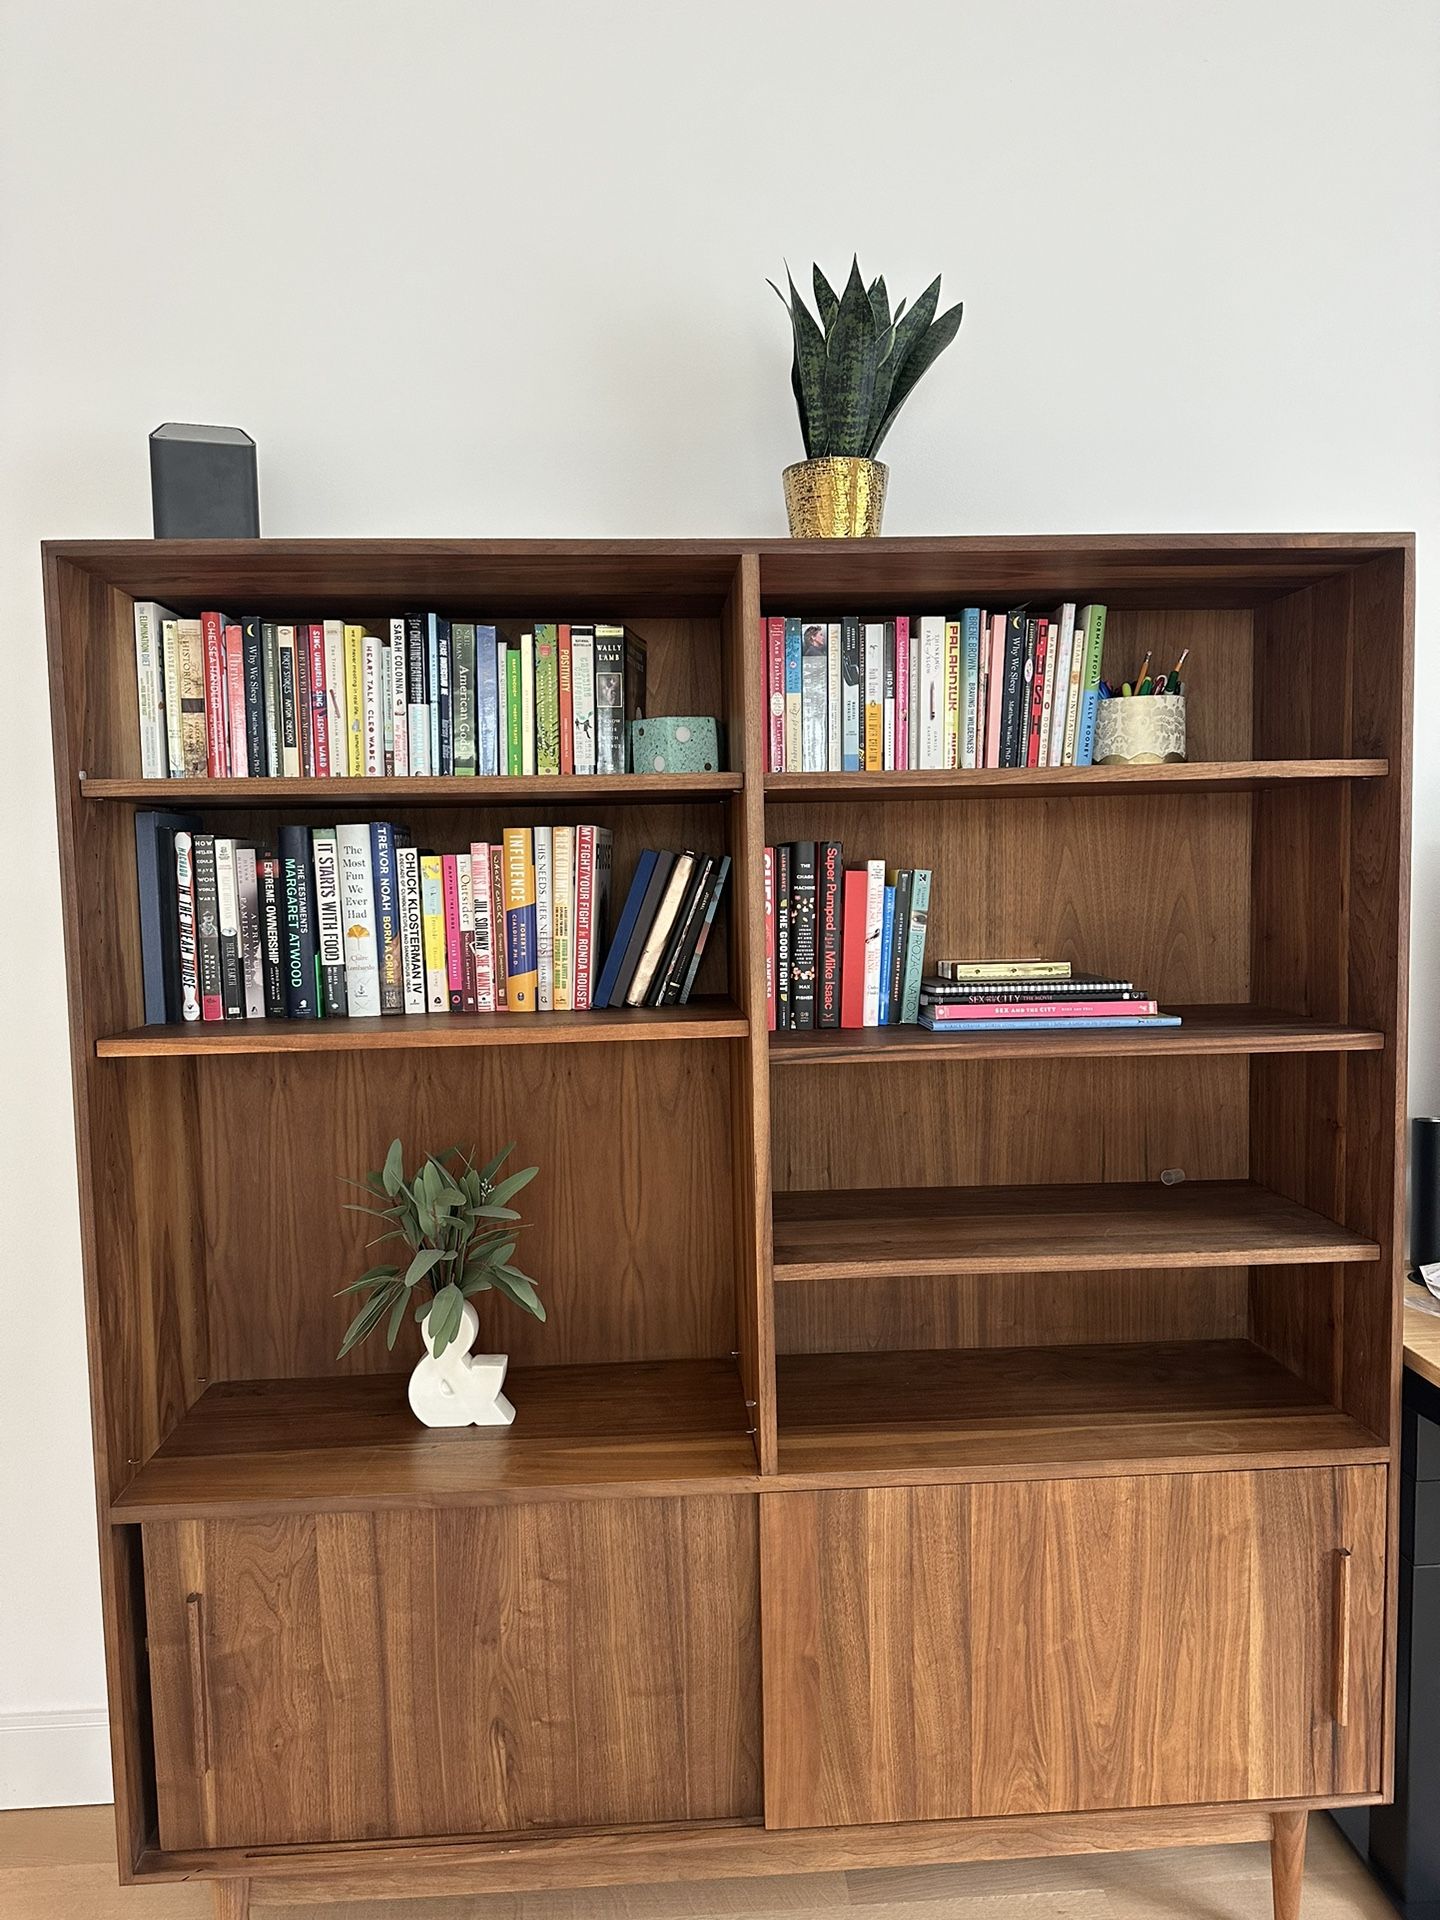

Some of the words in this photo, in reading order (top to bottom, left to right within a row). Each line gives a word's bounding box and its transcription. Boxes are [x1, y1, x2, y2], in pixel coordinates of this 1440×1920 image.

[140, 615, 149, 653] ELIMINATION
[207, 621, 215, 664] CHELSEA
[312, 630, 320, 649] SING,
[394, 624, 402, 652] SARAH
[410, 630, 422, 660] CHEATING
[439, 640, 447, 656] PLEASE
[1011, 637, 1020, 656] Why
[1094, 616, 1102, 651] NORMAL
[142, 654, 150, 666] DIET
[247, 645, 257, 665] Why
[282, 651, 291, 669] FORTY
[830, 629, 838, 670] Modern
[968, 643, 977, 670] BROWN
[1011, 657, 1019, 670] We
[182, 640, 192, 694] HISTORIAN
[228, 652, 241, 689] Thrive
[249, 666, 258, 680] We
[298, 650, 307, 694] BELOVED
[314, 652, 322, 690] UNBURIED,
[395, 655, 403, 695] COLONNA
[411, 661, 423, 682] DEATH
[440, 657, 448, 686] UNDERSTAND
[561, 649, 570, 692] POSITIVITY
[949, 625, 958, 711] PALAHNIUK
[1046, 663, 1054, 695] OLIVER
[210, 666, 219, 709] HANDLER
[249, 681, 258, 704] Sleep
[283, 671, 291, 694] STORIES
[459, 665, 469, 720] American
[831, 672, 839, 698] Love
[968, 683, 976, 708] BRAVING
[1008, 672, 1018, 694] Sleep
[284, 699, 292, 718] ANTON
[315, 690, 324, 707] SING
[285, 720, 294, 745] CHEKHOV
[317, 714, 326, 743] JESMYN
[460, 723, 470, 750] Gods
[967, 716, 975, 754] WILDERNESS
[1066, 700, 1076, 748] INVITATION
[1084, 725, 1092, 758] ROONEY
[319, 746, 327, 767] WARD
[318, 843, 333, 853] IT
[581, 827, 591, 841] MY
[178, 847, 187, 878] MACHADO
[343, 859, 366, 867] Most
[344, 846, 362, 855] The
[378, 827, 388, 874] TREVOR
[538, 844, 546, 862] HIS
[825, 847, 837, 881] Super
[297, 864, 305, 879] THE
[318, 857, 335, 898] STARTS
[346, 871, 364, 880] Fun
[405, 852, 416, 895] CHUCK
[473, 861, 486, 886] WANTS
[510, 834, 524, 901] INFLUENCE
[538, 864, 547, 898] NEEDS,
[555, 829, 569, 904] FREAKONOMICS
[580, 844, 591, 900] FIGHT/YOUR
[179, 885, 191, 895] IN
[264, 862, 274, 903] EXTREME
[285, 858, 299, 929] MARGARET
[348, 885, 364, 894] We
[381, 878, 391, 910] NOAH
[180, 900, 192, 918] THE
[298, 881, 308, 933] TESTAMENTS
[345, 897, 368, 906] Ever
[460, 874, 472, 924] Outsider
[475, 899, 488, 914] JILL
[539, 901, 547, 920] HER
[824, 883, 837, 930] Pumped
[240, 897, 248, 938] FAMILY
[321, 901, 337, 930] WITH
[347, 910, 367, 919] Had
[579, 902, 590, 929] FIGHT
[779, 909, 787, 928] THE
[181, 922, 193, 953] DREAM
[266, 905, 279, 964] OWNERSHIP
[382, 916, 392, 944] BORN
[408, 899, 421, 979] KLOSTERMAN
[474, 917, 489, 951] SOLOWAY
[539, 924, 548, 956] NEEDS
[226, 943, 235, 957] HERE
[323, 934, 339, 961] FOOD
[577, 938, 588, 970] RONDA
[779, 931, 787, 959] GOOD
[910, 934, 922, 976] PROZAC
[182, 958, 195, 988] HOUSE
[289, 933, 302, 988] ATWOOD
[384, 954, 395, 984] CRIME
[477, 955, 489, 967] SHE
[825, 951, 836, 979] Mike
[228, 968, 236, 986] EARTH
[412, 983, 422, 994] IV
[477, 971, 490, 996] WANTS
[576, 972, 587, 1009] ROUSEY
[824, 981, 835, 1010] Isaac
[906, 980, 917, 1021] NATION
[969, 996, 984, 1004] SEX
[997, 995, 1020, 1003] CITY
